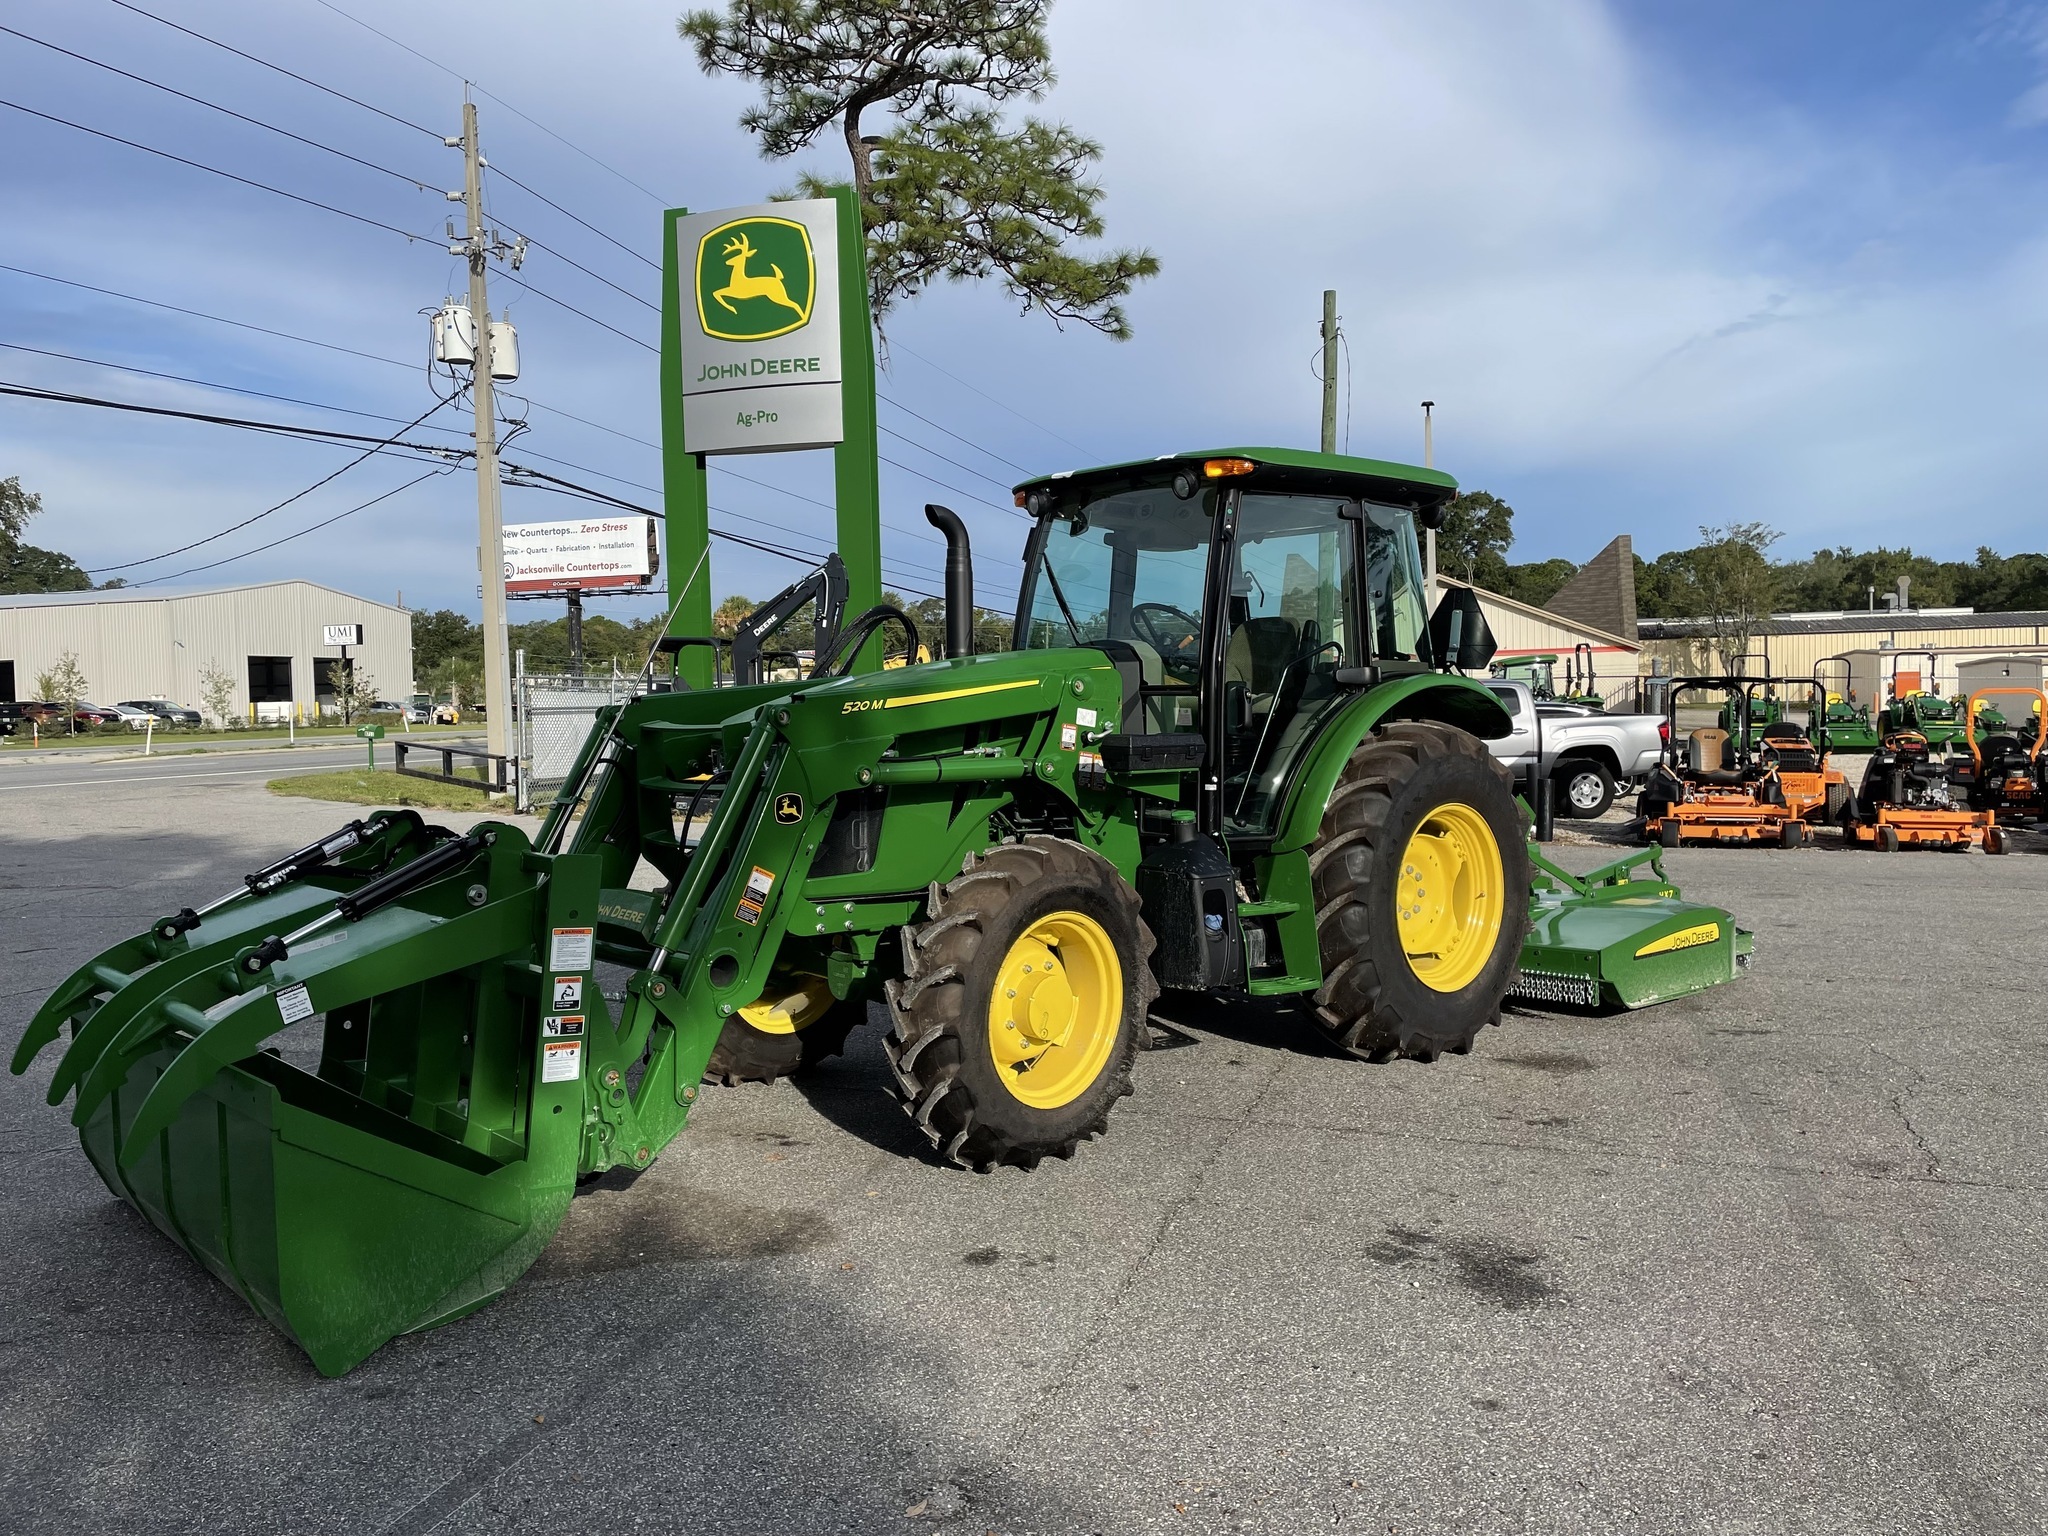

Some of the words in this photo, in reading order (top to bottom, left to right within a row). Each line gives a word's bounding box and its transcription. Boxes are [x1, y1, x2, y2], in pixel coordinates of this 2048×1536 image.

[697, 362, 747, 383] JOHN
[750, 357, 821, 376] DEERE
[736, 410, 778, 427] Ag-Pro
[580, 524, 600, 533] Zero
[601, 523, 629, 532] Stress
[526, 547, 548, 555] Quartz
[555, 544, 591, 552] Fabrication
[598, 541, 635, 550] Installation
[516, 563, 565, 575] Jacksonville
[328, 626, 352, 638] UMI
[752, 613, 778, 637] DEERE
[841, 699, 884, 715] 520M
[611, 905, 645, 924] DEERE
[1672, 936, 1691, 948] JOHN
[1691, 930, 1714, 945] DEERE
